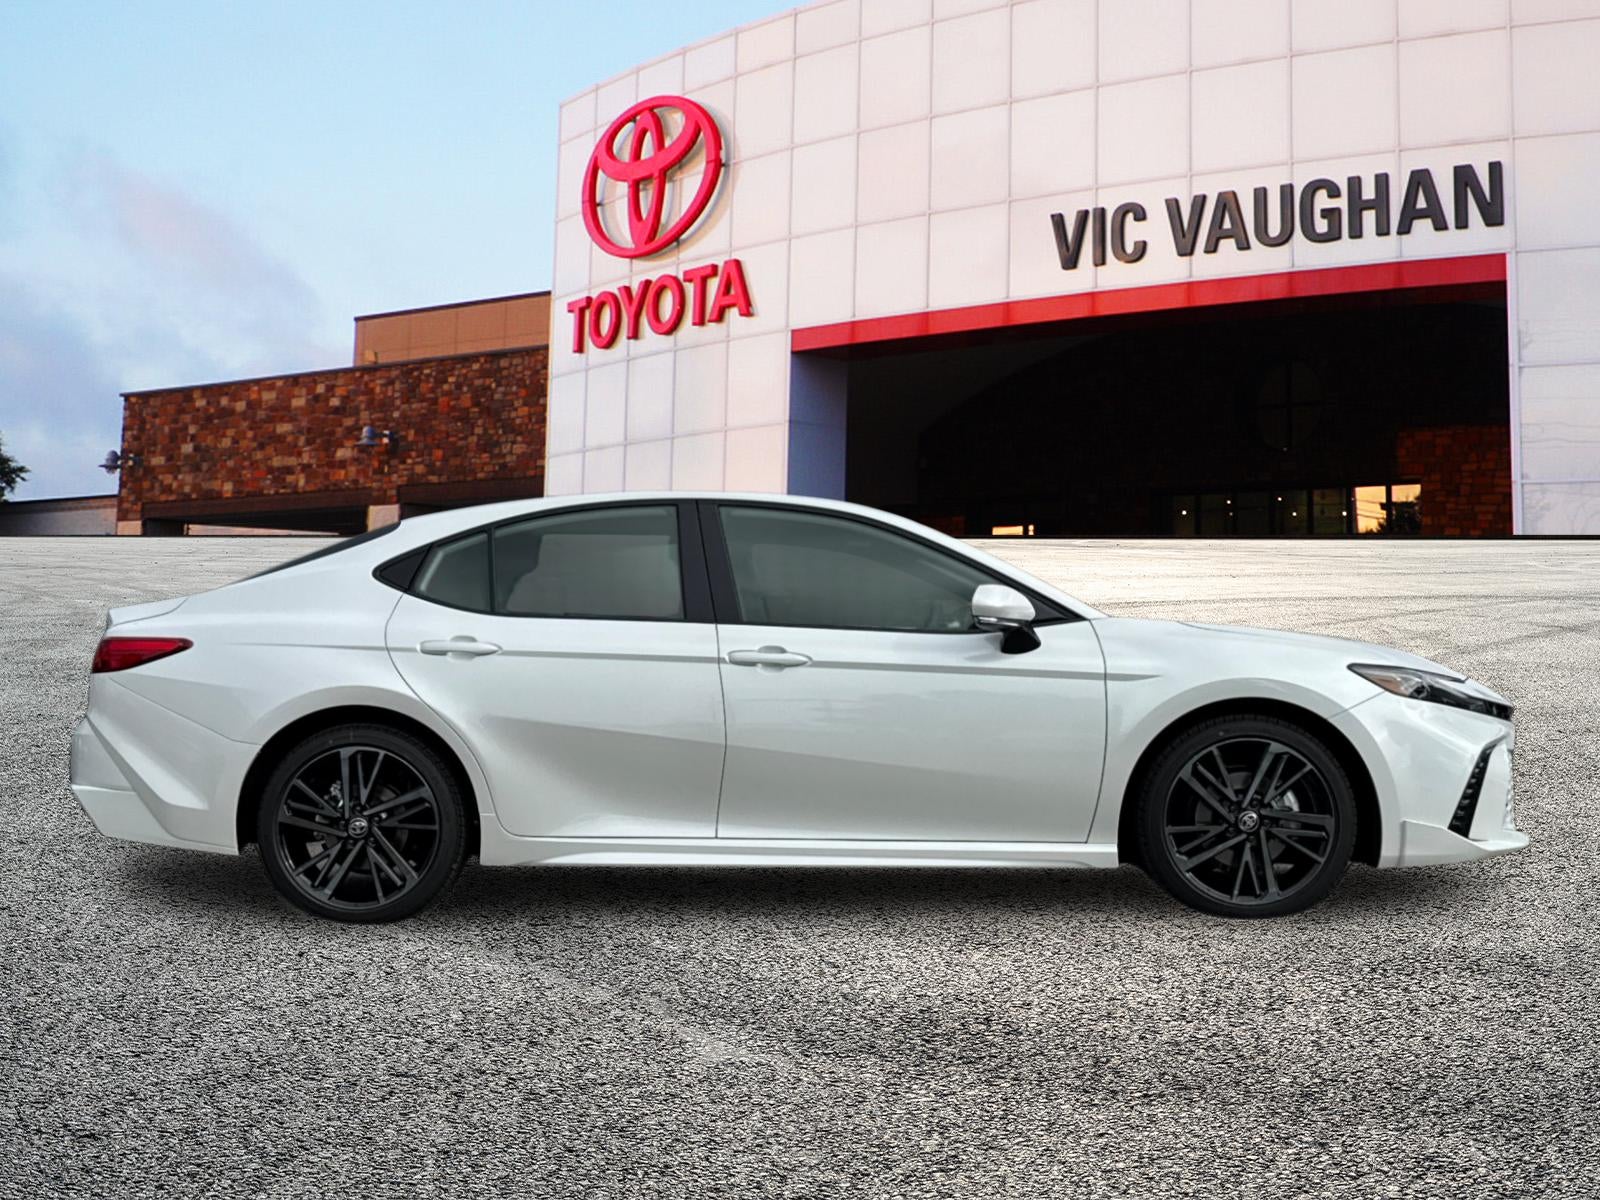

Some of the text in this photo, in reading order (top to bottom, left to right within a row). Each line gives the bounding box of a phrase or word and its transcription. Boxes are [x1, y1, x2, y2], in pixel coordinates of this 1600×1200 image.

[1050, 160, 1505, 271] VIC VAUGHAN
[567, 258, 754, 354] TOYOTA
